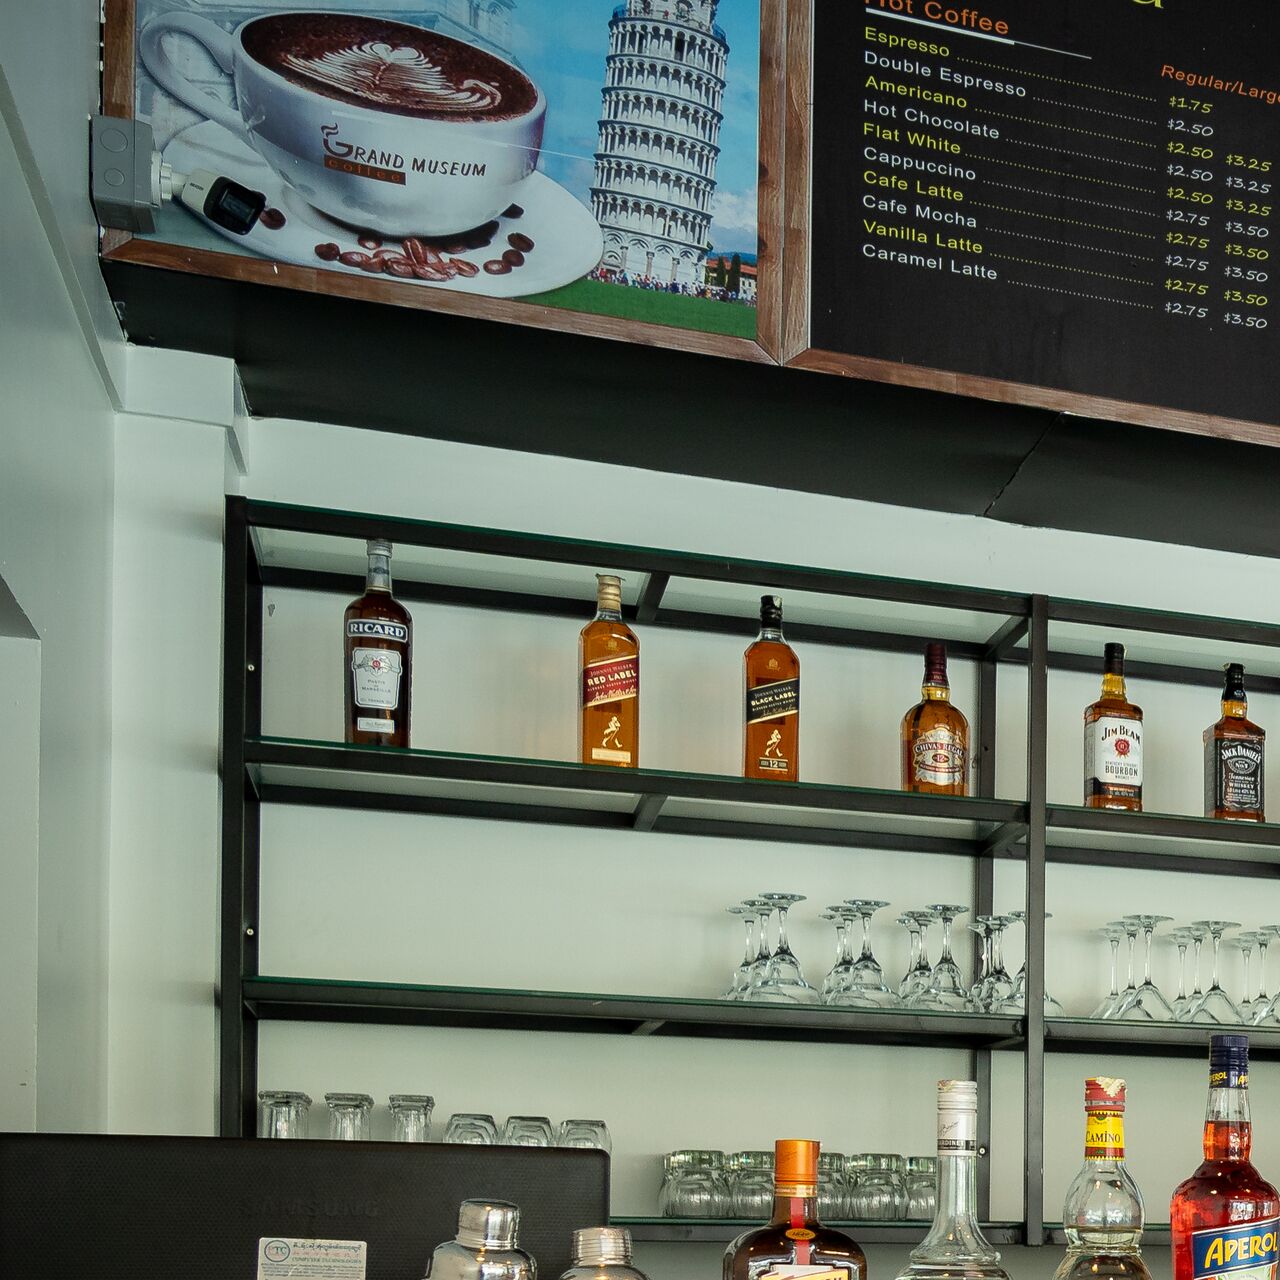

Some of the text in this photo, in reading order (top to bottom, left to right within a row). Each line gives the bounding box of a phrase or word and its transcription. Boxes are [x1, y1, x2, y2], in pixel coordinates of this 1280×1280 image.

[865, 0, 1008, 34] ot Coffee
[866, 27, 1213, 113] Espresso $1.75
[865, 51, 1213, 136] Double Espresso $2.50
[866, 76, 1271, 171] Americano $2.50 $3.25
[323, 138, 486, 177] GRAND MUSEUM
[865, 100, 1271, 193] Hot Chocolate $2.50 $3.25
[864, 147, 1268, 237] Cappuccino $2.75 $3.50
[864, 171, 1268, 259] Cafe Latte $2.75 $3.50
[864, 219, 1267, 306] Vanilla Latte $2.75 $3.50
[350, 623, 405, 637] RICARD
[588, 676, 606, 687] RED
[608, 669, 637, 681] LABEL
[751, 695, 773, 706] BLACK
[774, 691, 797, 701] LABEL
[1102, 727, 1117, 741] JIM
[769, 760, 778, 768] 12
[1105, 765, 1138, 777] BOURBON
[1221, 747, 1237, 760] JACK
[1204, 1231, 1277, 1269] APEROL
